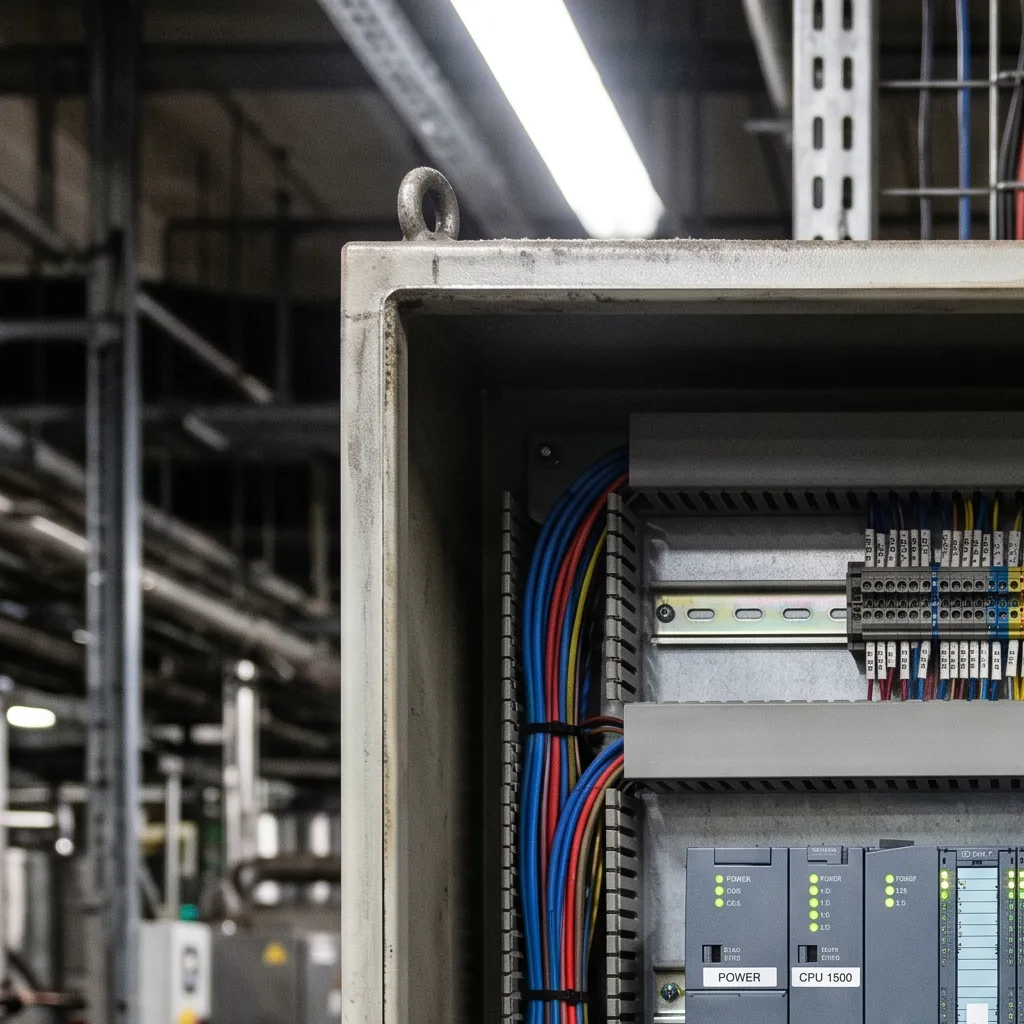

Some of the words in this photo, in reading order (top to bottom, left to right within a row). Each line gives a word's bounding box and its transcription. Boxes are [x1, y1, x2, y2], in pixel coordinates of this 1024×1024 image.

[718, 972, 761, 982] POWER
[799, 972, 824, 983] CPU
[827, 972, 853, 983] 1500
